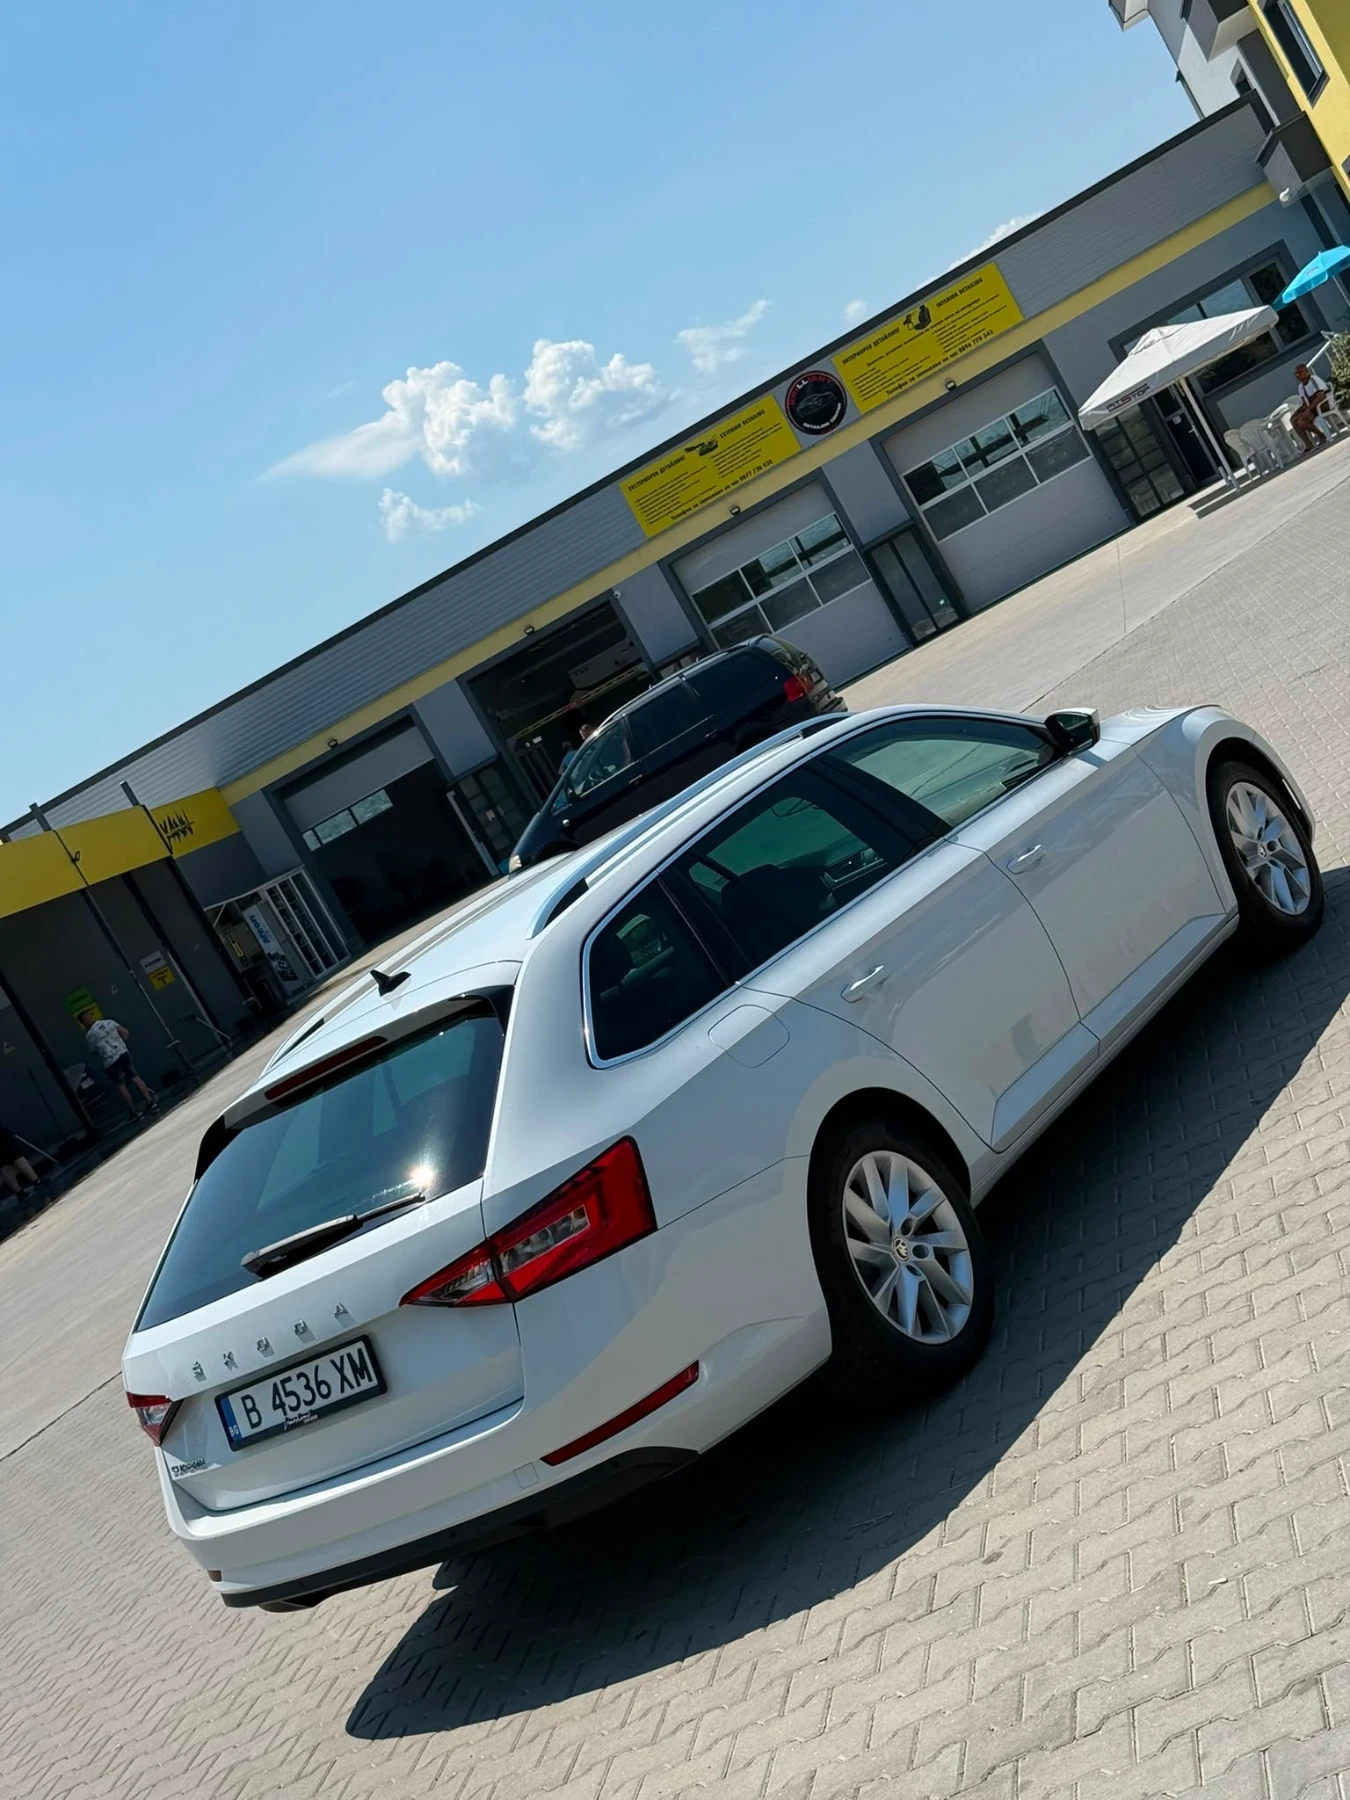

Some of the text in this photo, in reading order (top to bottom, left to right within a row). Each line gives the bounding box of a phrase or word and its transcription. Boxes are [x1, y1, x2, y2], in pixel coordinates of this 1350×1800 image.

[241, 1394, 262, 1429] B
[272, 1365, 331, 1417] 4536
[330, 1348, 373, 1394] XM
[228, 1425, 240, 1436] BG
